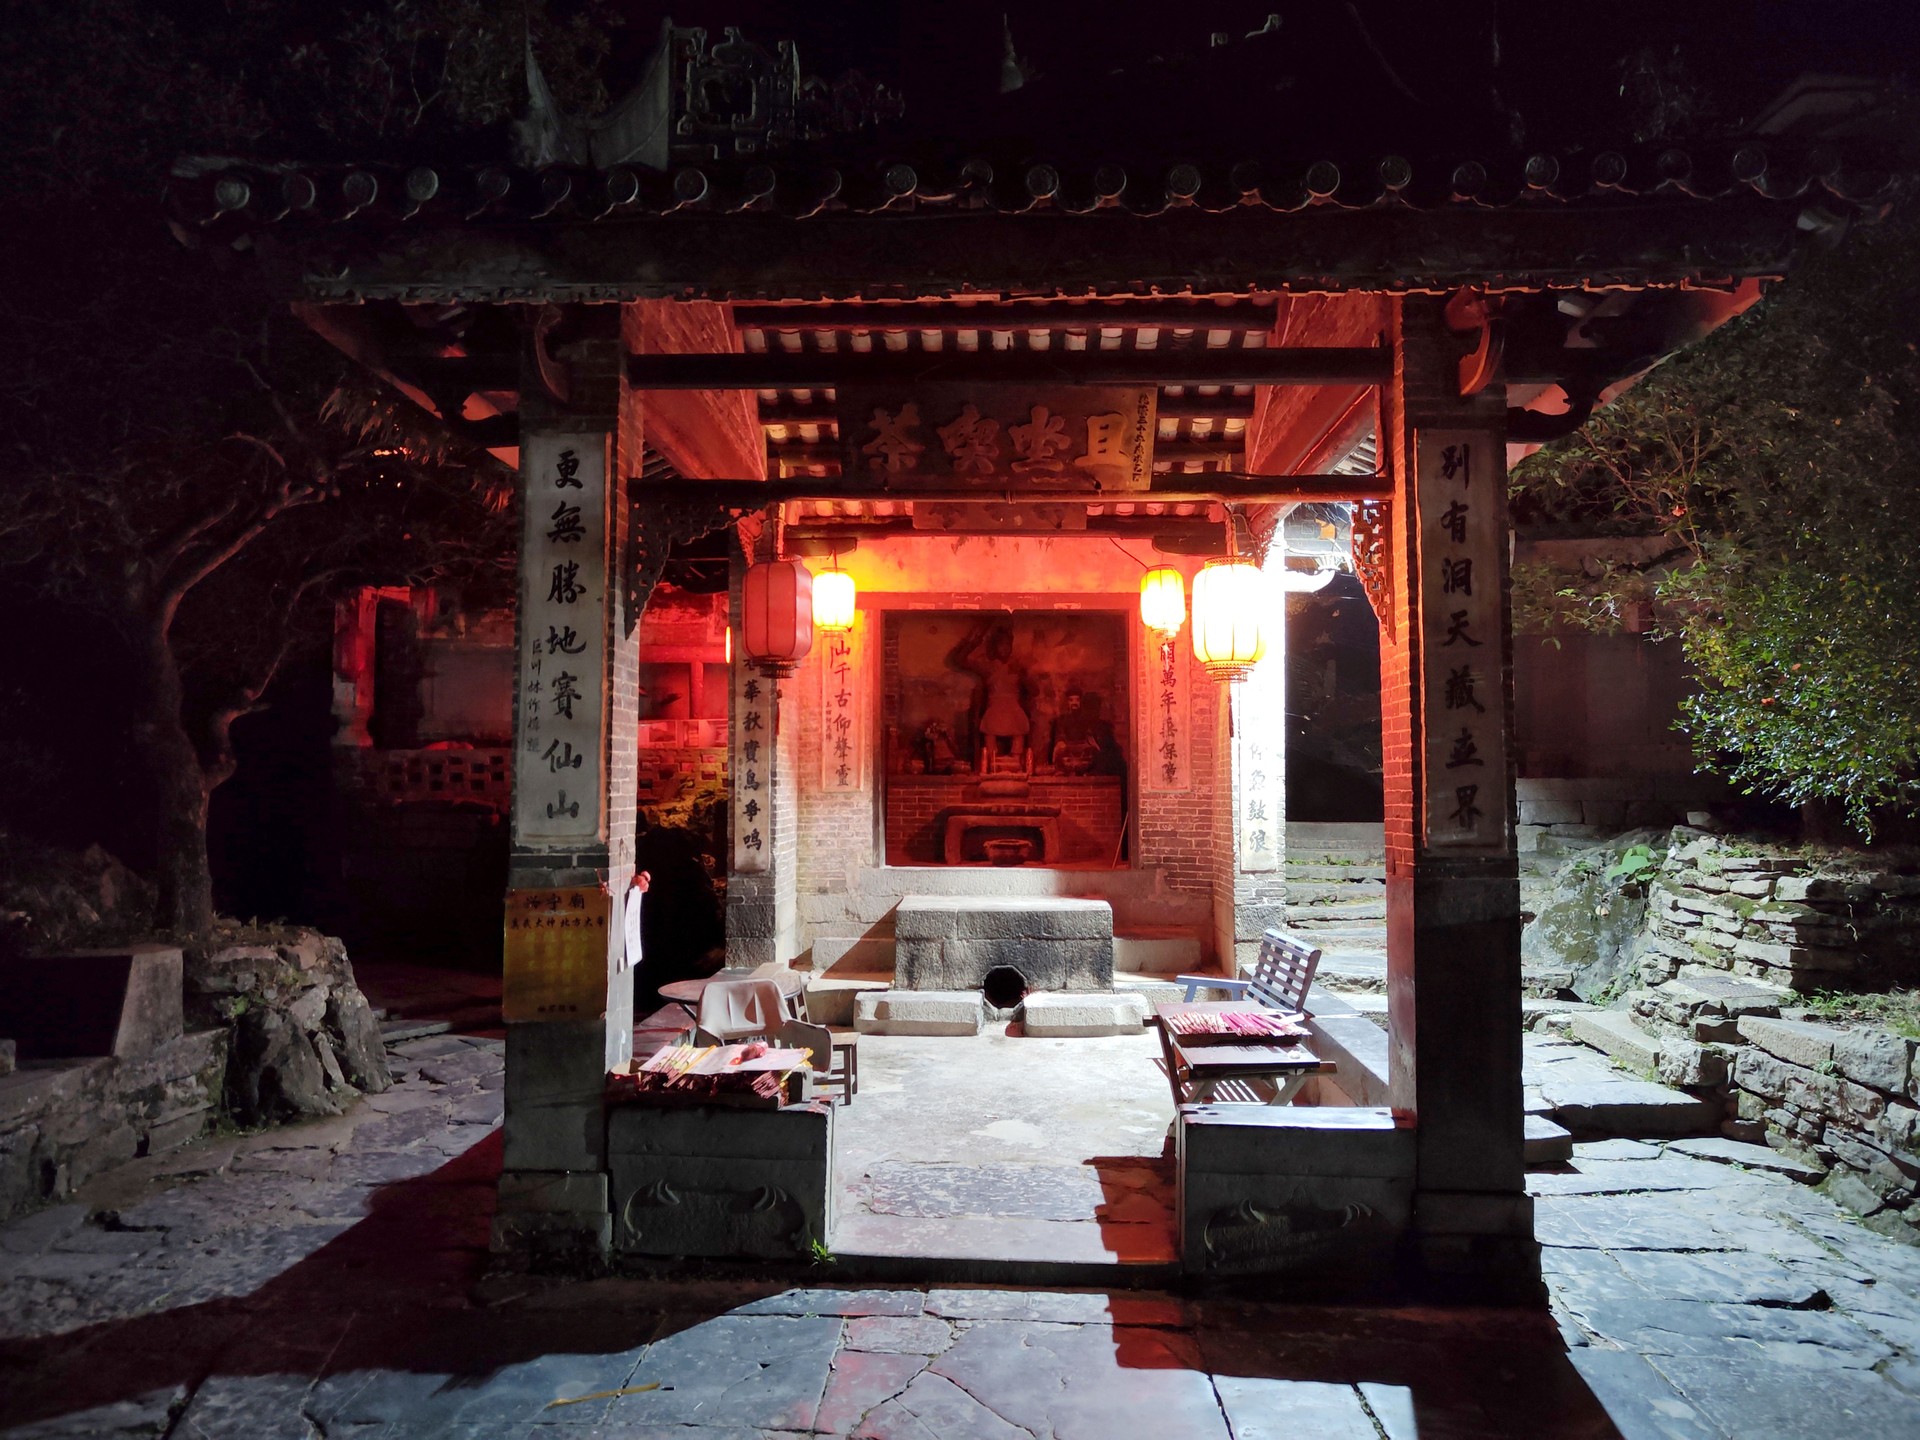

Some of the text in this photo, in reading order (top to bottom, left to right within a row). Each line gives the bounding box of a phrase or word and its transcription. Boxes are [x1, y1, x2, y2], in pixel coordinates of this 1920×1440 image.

[540, 448, 587, 821] 更無勝地賽仙山
